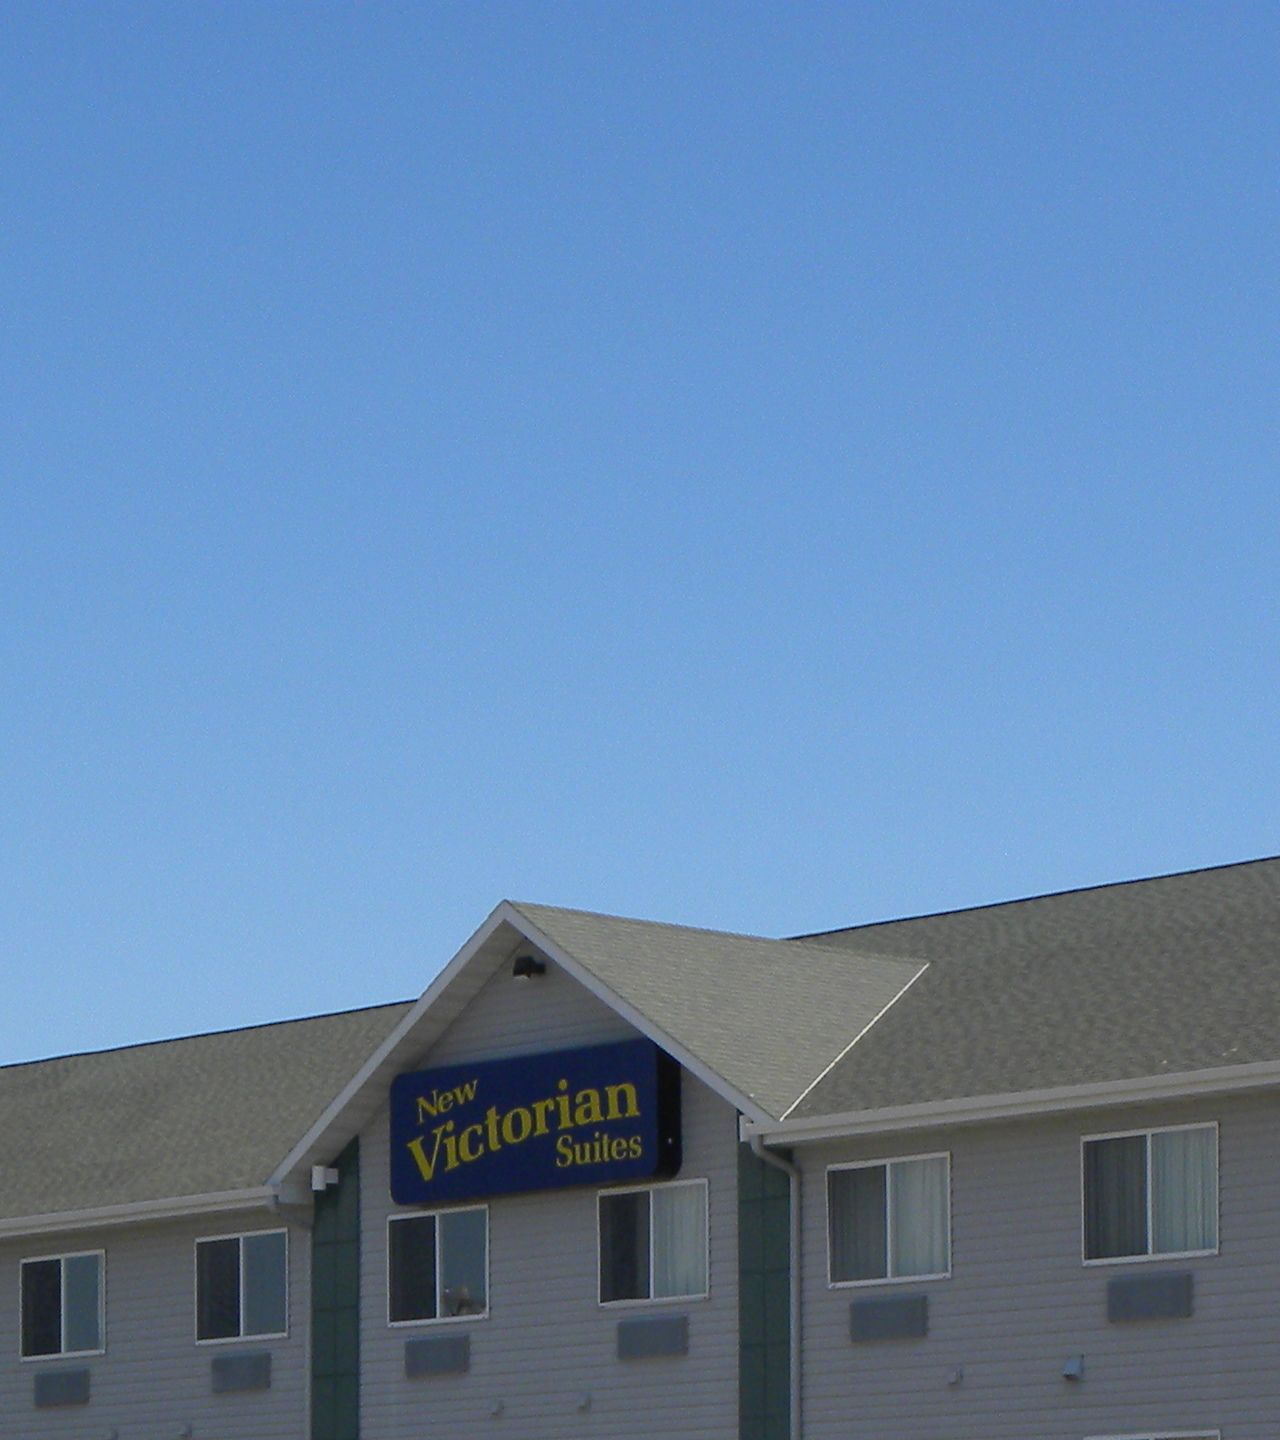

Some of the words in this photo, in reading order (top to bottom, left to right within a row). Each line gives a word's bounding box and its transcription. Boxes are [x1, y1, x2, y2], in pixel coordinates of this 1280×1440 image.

[416, 1078, 478, 1125] New
[406, 1078, 641, 1183] Victorian
[555, 1131, 642, 1168] Suites
